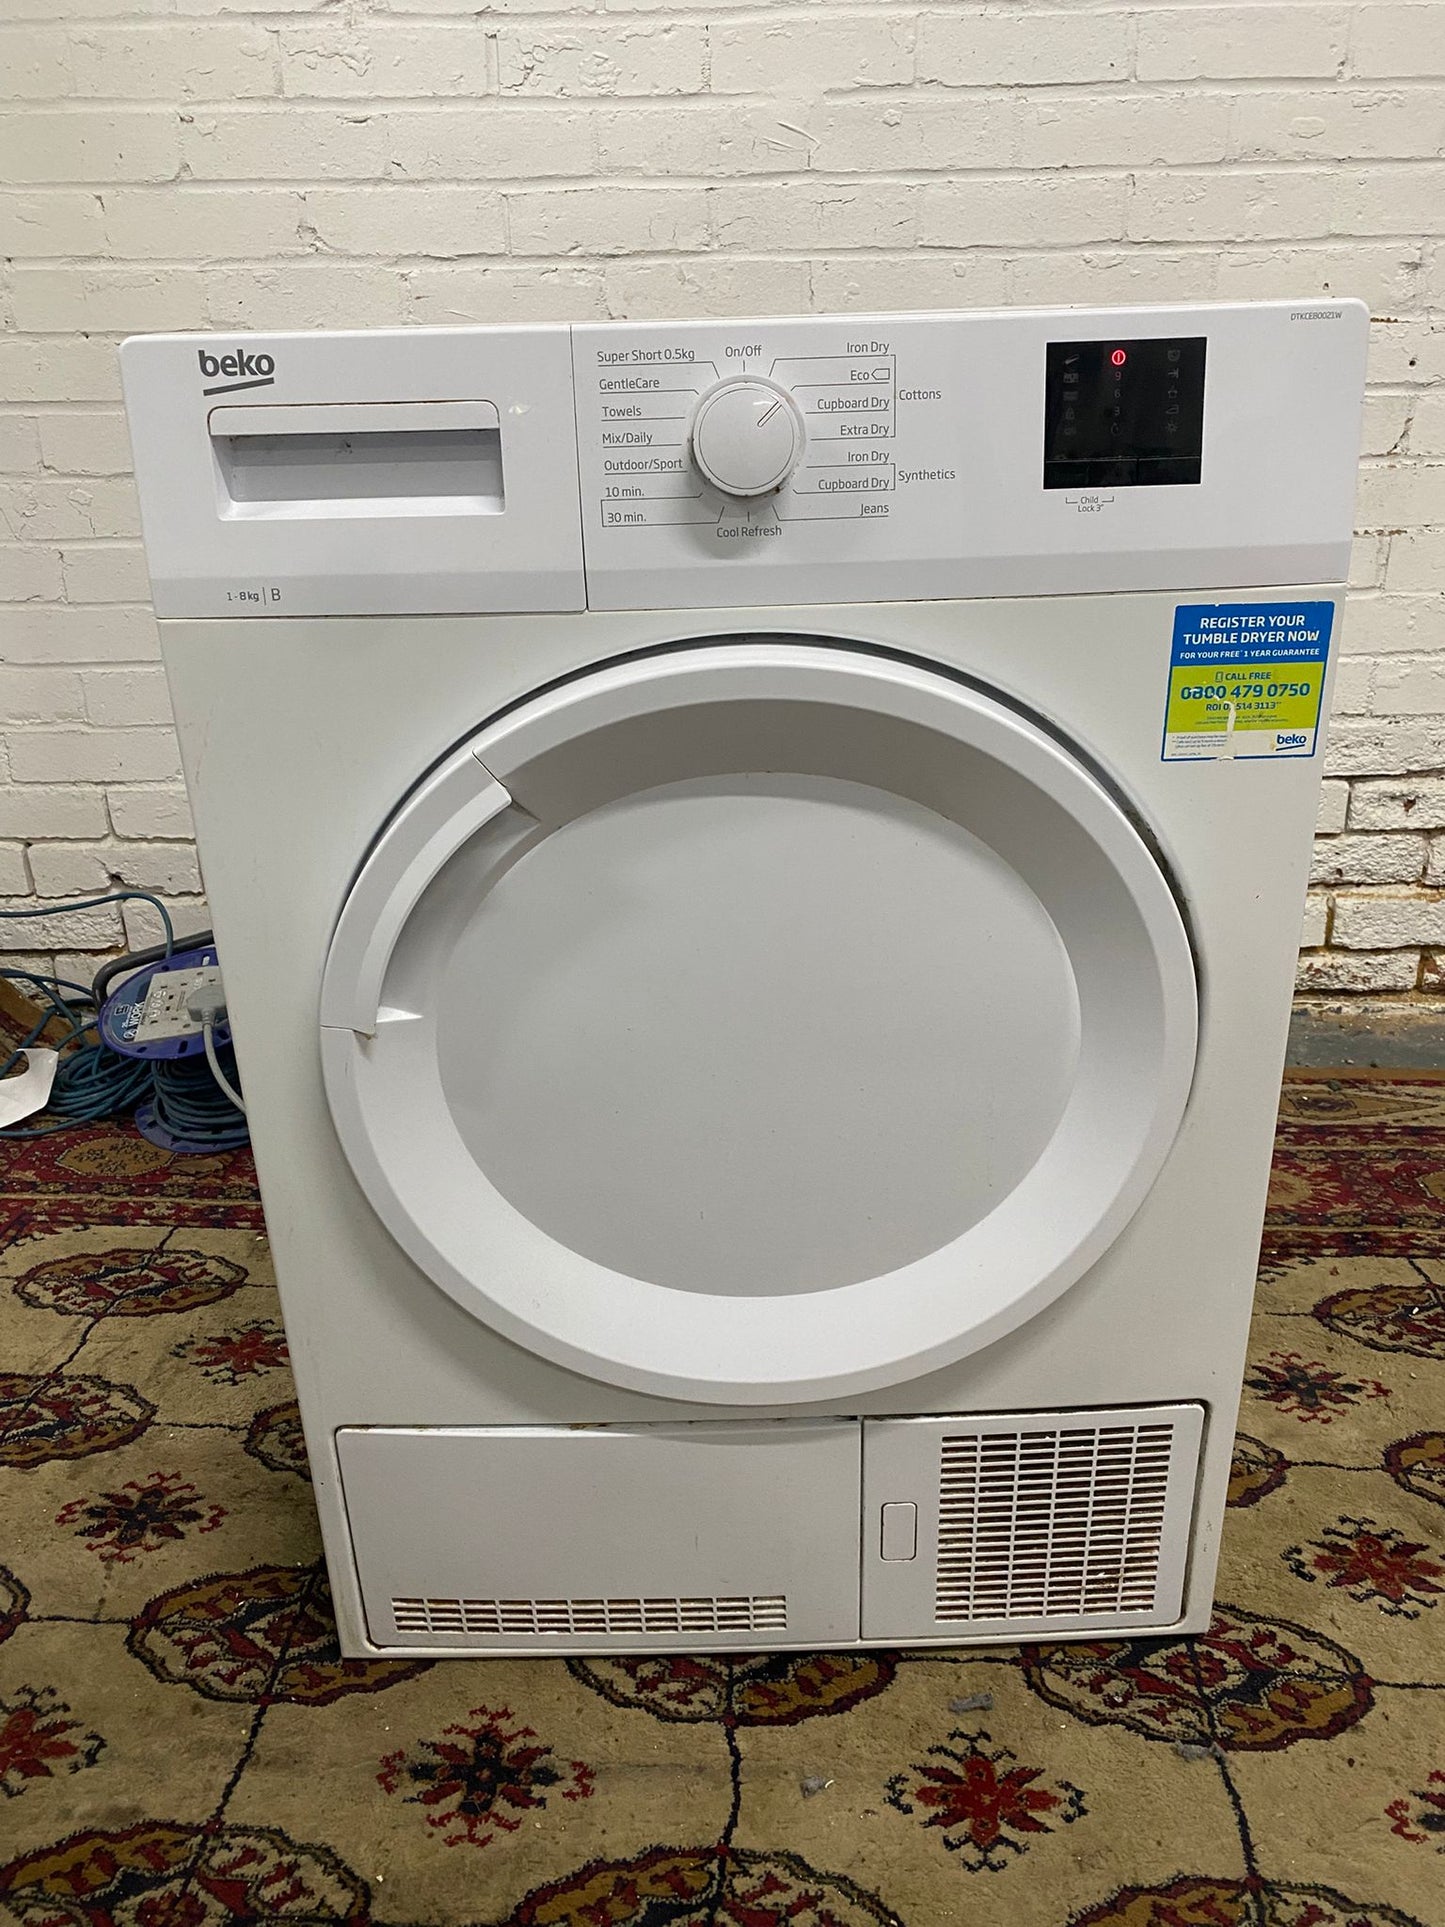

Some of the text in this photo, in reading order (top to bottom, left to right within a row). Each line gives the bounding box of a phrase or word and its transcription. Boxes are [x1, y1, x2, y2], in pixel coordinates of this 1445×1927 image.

[725, 345, 762, 357] On/Off
[847, 341, 890, 354] Iron Dry
[597, 348, 695, 363] Super Short 0.5kg
[198, 349, 275, 378] beko
[850, 370, 870, 381] Eco
[599, 378, 660, 390] GentleCare
[899, 389, 942, 401] Cottons
[817, 397, 890, 411] Cupboard Dry
[602, 405, 642, 417] Towels
[840, 424, 890, 437] Extra Dry
[602, 432, 653, 445] Mix/Daily
[848, 451, 890, 463] Iron Dry
[604, 458, 683, 471] Outdoor/Sport
[898, 469, 956, 483] Synthetics
[818, 477, 890, 492] Cupboard Dry
[605, 487, 645, 498] 10 min.
[1080, 496, 1099, 504] Child
[860, 503, 889, 516] Jeans
[1078, 504, 1094, 512] Lock
[607, 512, 647, 523] 30 min.
[716, 525, 782, 538] Cool Refresh
[271, 588, 281, 601] B
[1200, 615, 1305, 629] REGISTER YOUR
[1183, 630, 1320, 645] TUMBLE DRYER NOW
[1197, 651, 1219, 659] YOUR
[1250, 649, 1272, 657] YEAR
[1272, 648, 1320, 657] GUARANTEE
[1225, 672, 1272, 681] CALL FREE
[1181, 682, 1310, 700] 0800 479 0750
[1205, 703, 1221, 711] ROI
[1236, 702, 1252, 711] 514
[1276, 734, 1307, 745] beko
